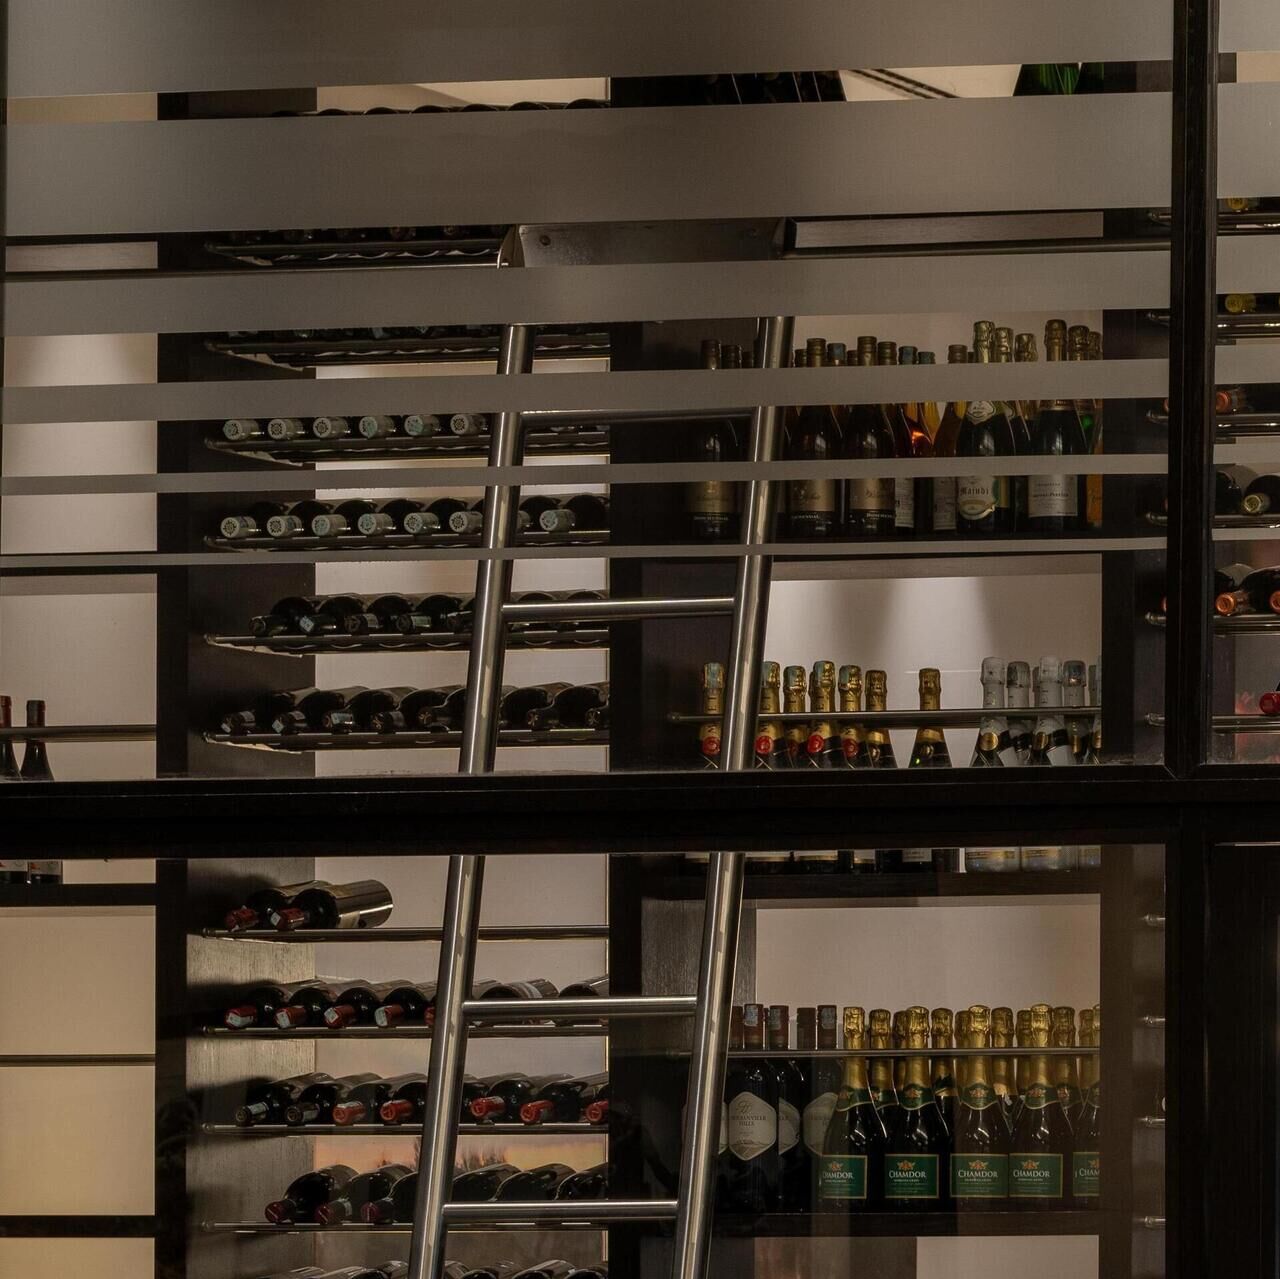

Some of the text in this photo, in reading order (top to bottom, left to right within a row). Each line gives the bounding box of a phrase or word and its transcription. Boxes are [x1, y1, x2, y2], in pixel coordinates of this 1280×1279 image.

[888, 1170, 927, 1178] CHAMDOR
[957, 1169, 999, 1178] CHAMDOR
[1012, 1169, 1051, 1178] CHAMDOR
